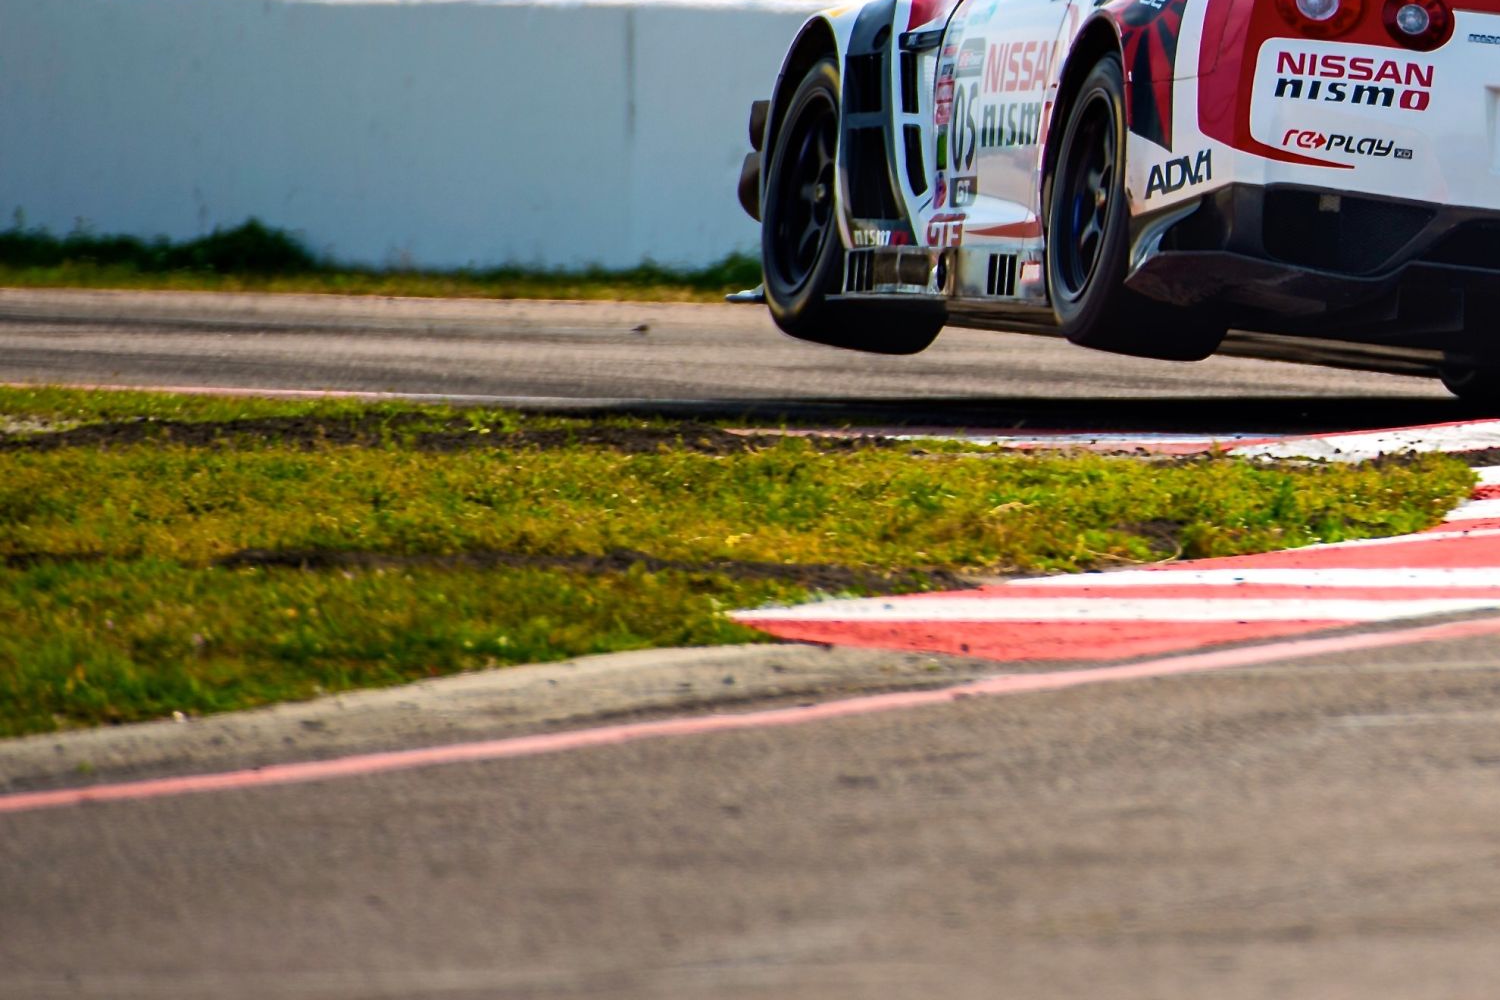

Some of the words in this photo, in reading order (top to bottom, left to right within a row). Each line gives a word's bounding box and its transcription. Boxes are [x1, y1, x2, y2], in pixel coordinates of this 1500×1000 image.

[1276, 51, 1434, 87] NISSAN
[1274, 78, 1430, 111] nismo
[952, 82, 978, 172] 05
[955, 179, 972, 204] GT
